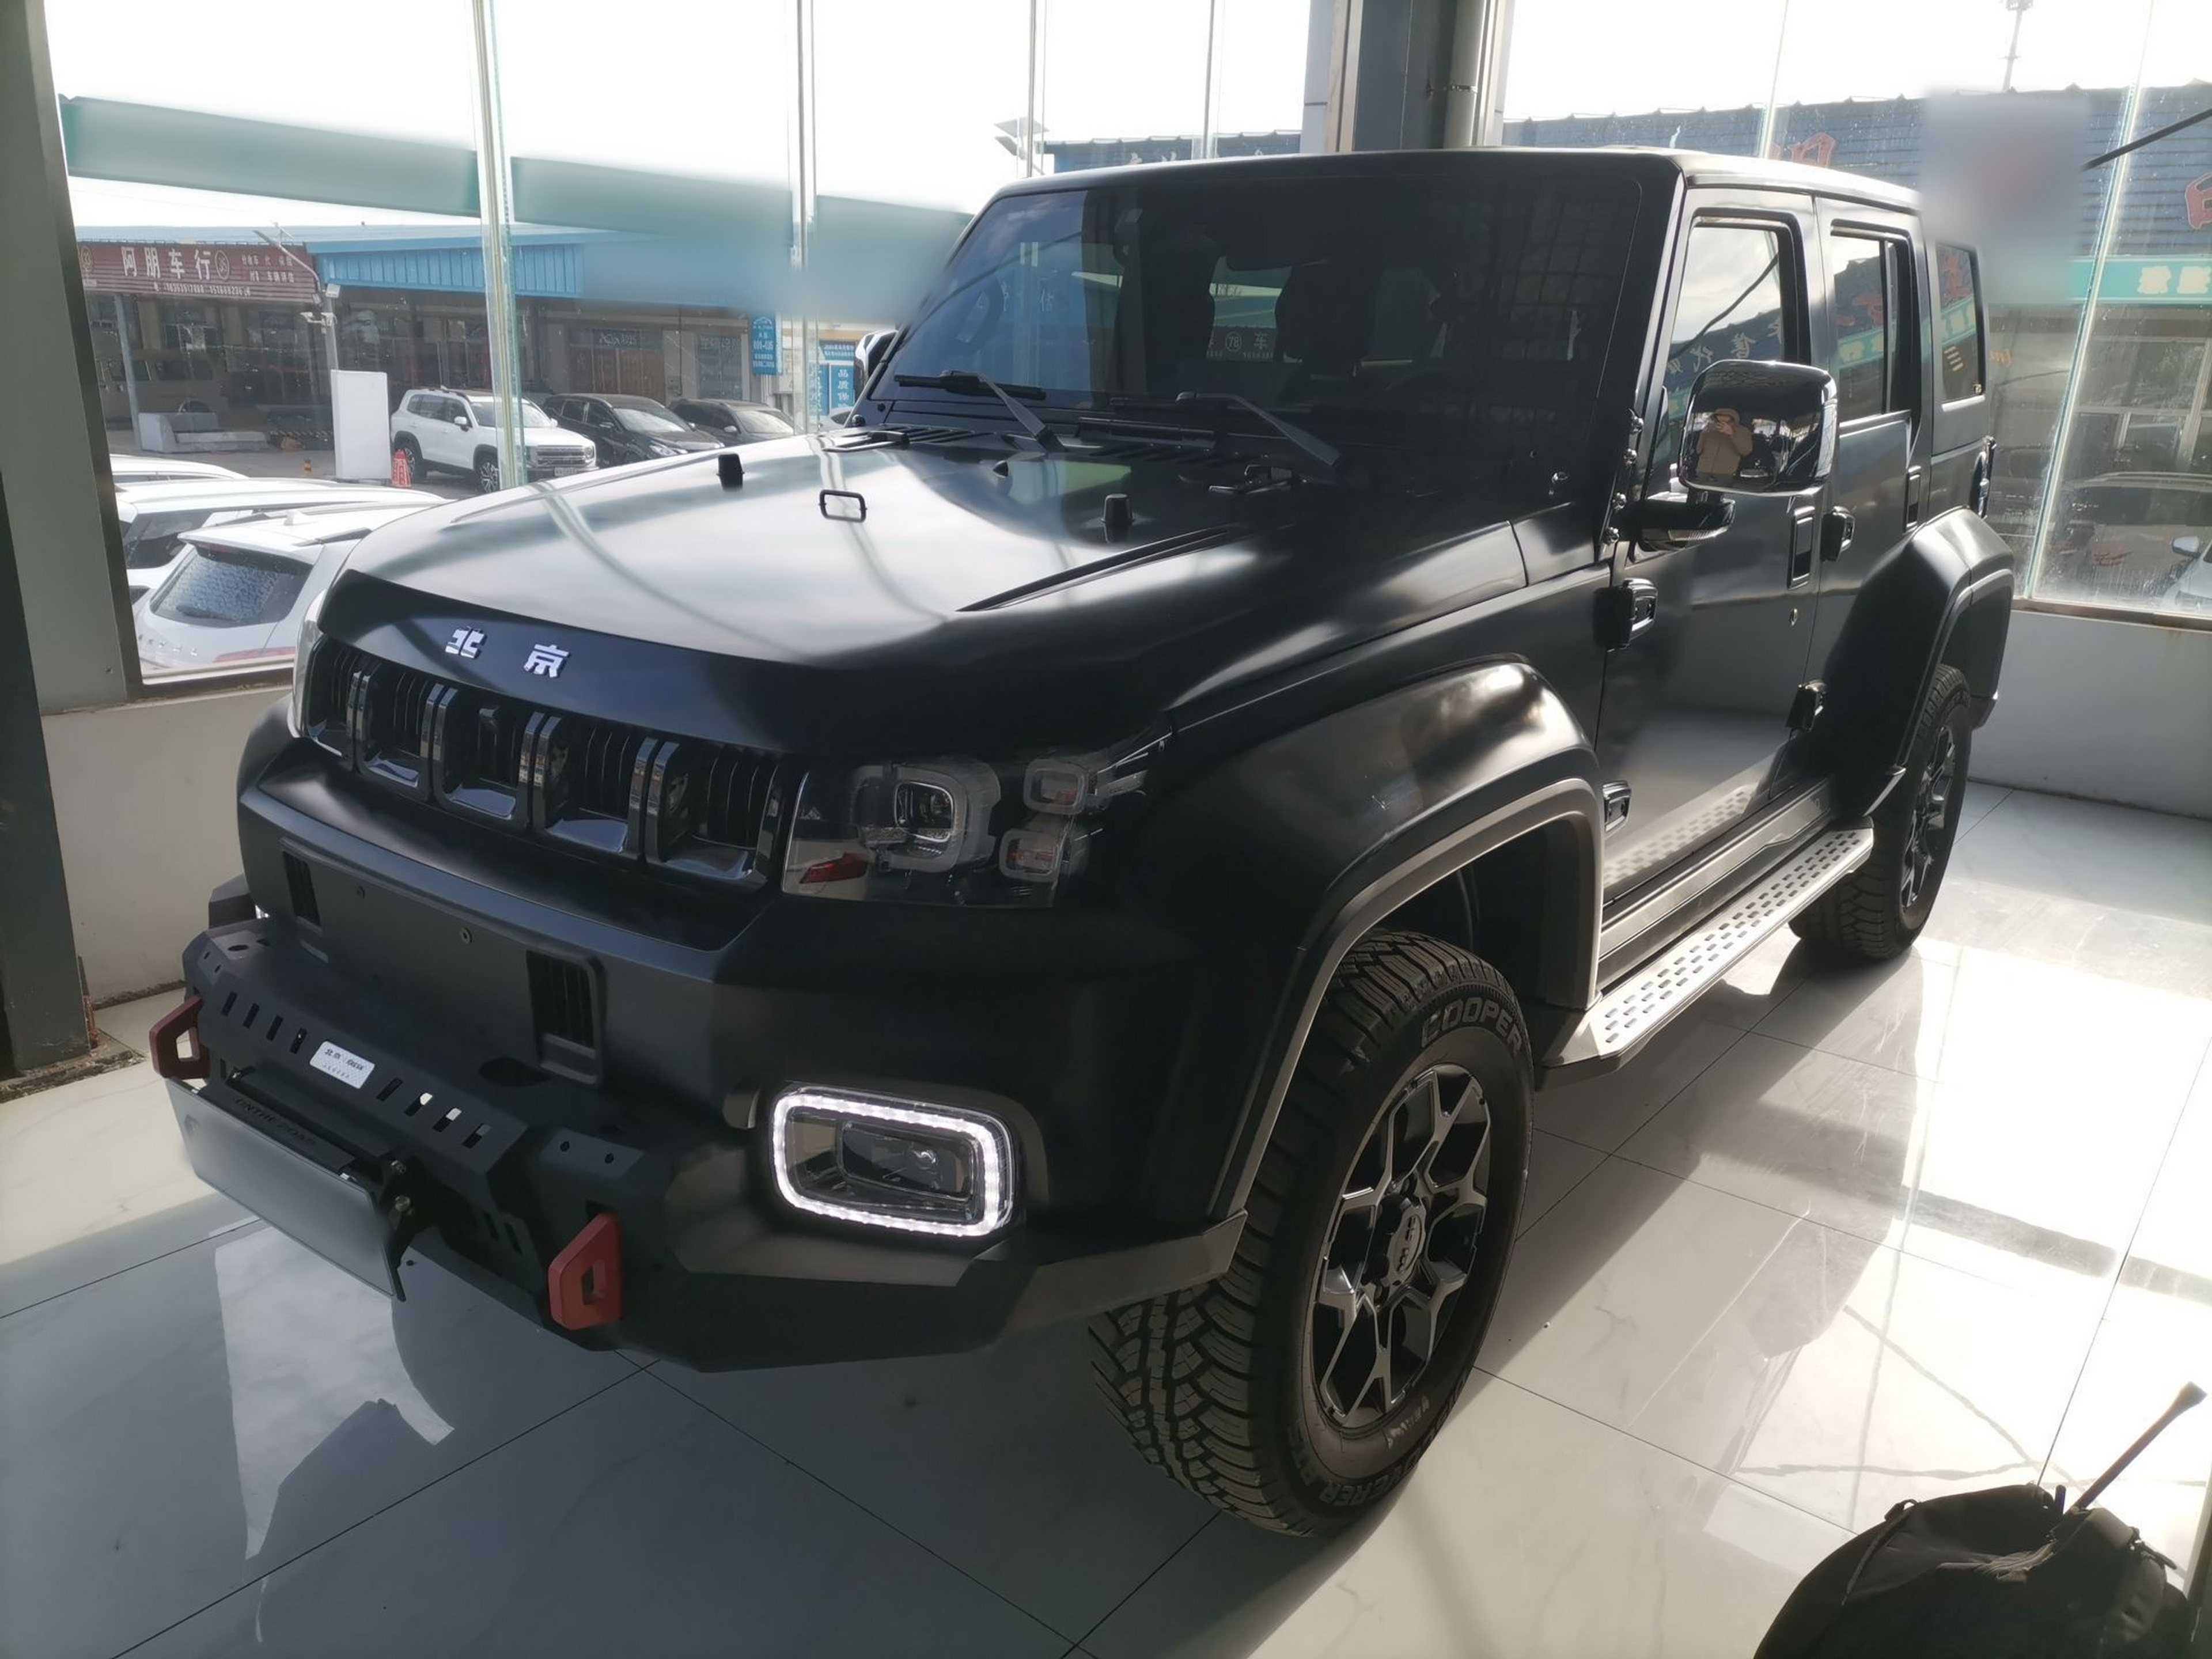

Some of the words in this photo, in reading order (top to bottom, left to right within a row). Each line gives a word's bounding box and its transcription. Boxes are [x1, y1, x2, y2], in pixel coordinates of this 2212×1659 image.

[121, 246, 211, 281] 阿朋车行
[445, 626, 570, 678] 北京
[1421, 997, 1523, 1057] COOPER
